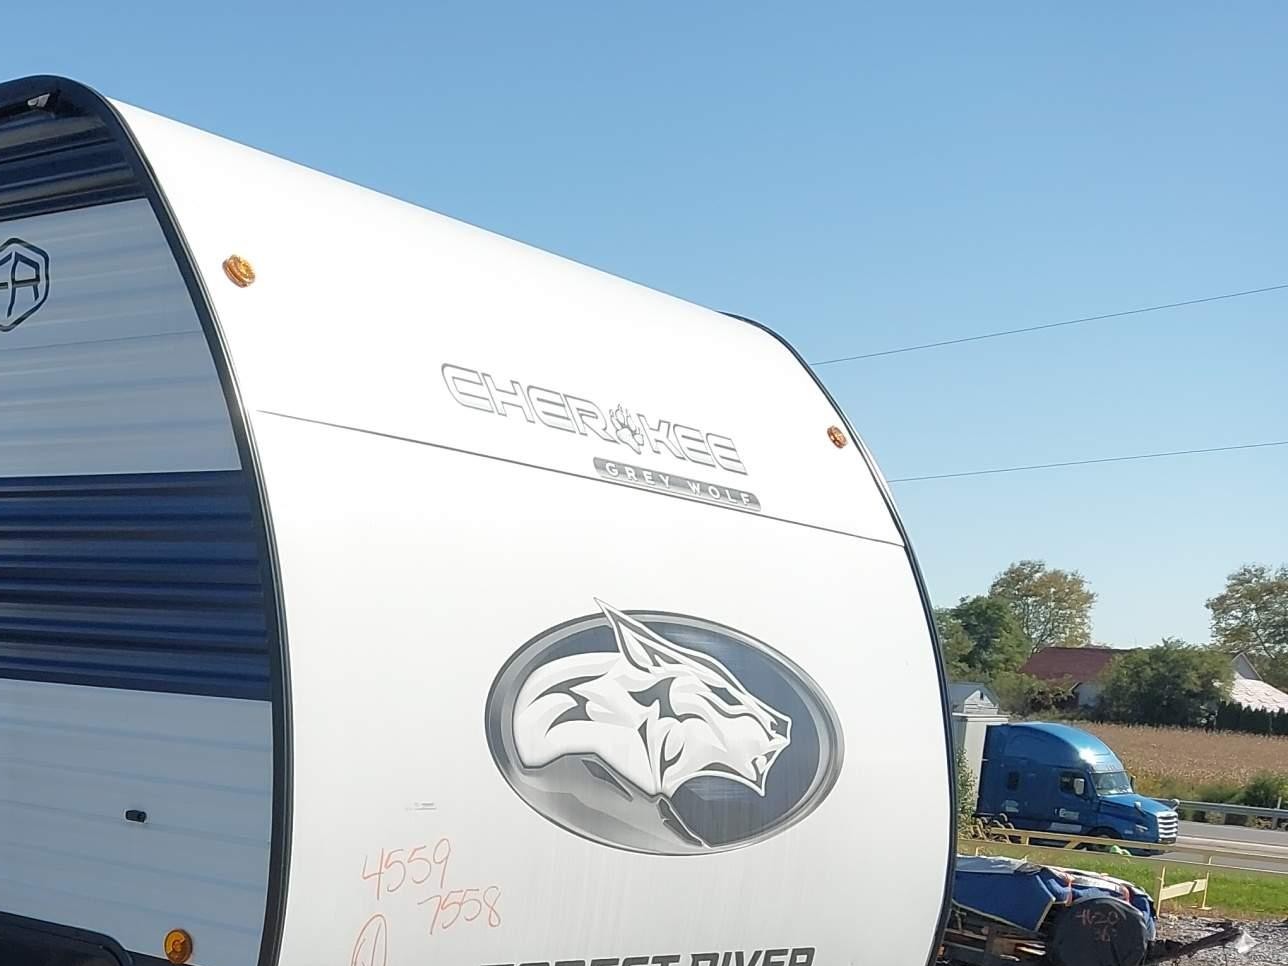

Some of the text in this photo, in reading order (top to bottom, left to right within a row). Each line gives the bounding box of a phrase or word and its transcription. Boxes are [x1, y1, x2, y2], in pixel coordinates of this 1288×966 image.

[604, 462, 752, 506] GREY WOLF
[361, 838, 452, 901] 4559
[417, 885, 502, 936] 7558
